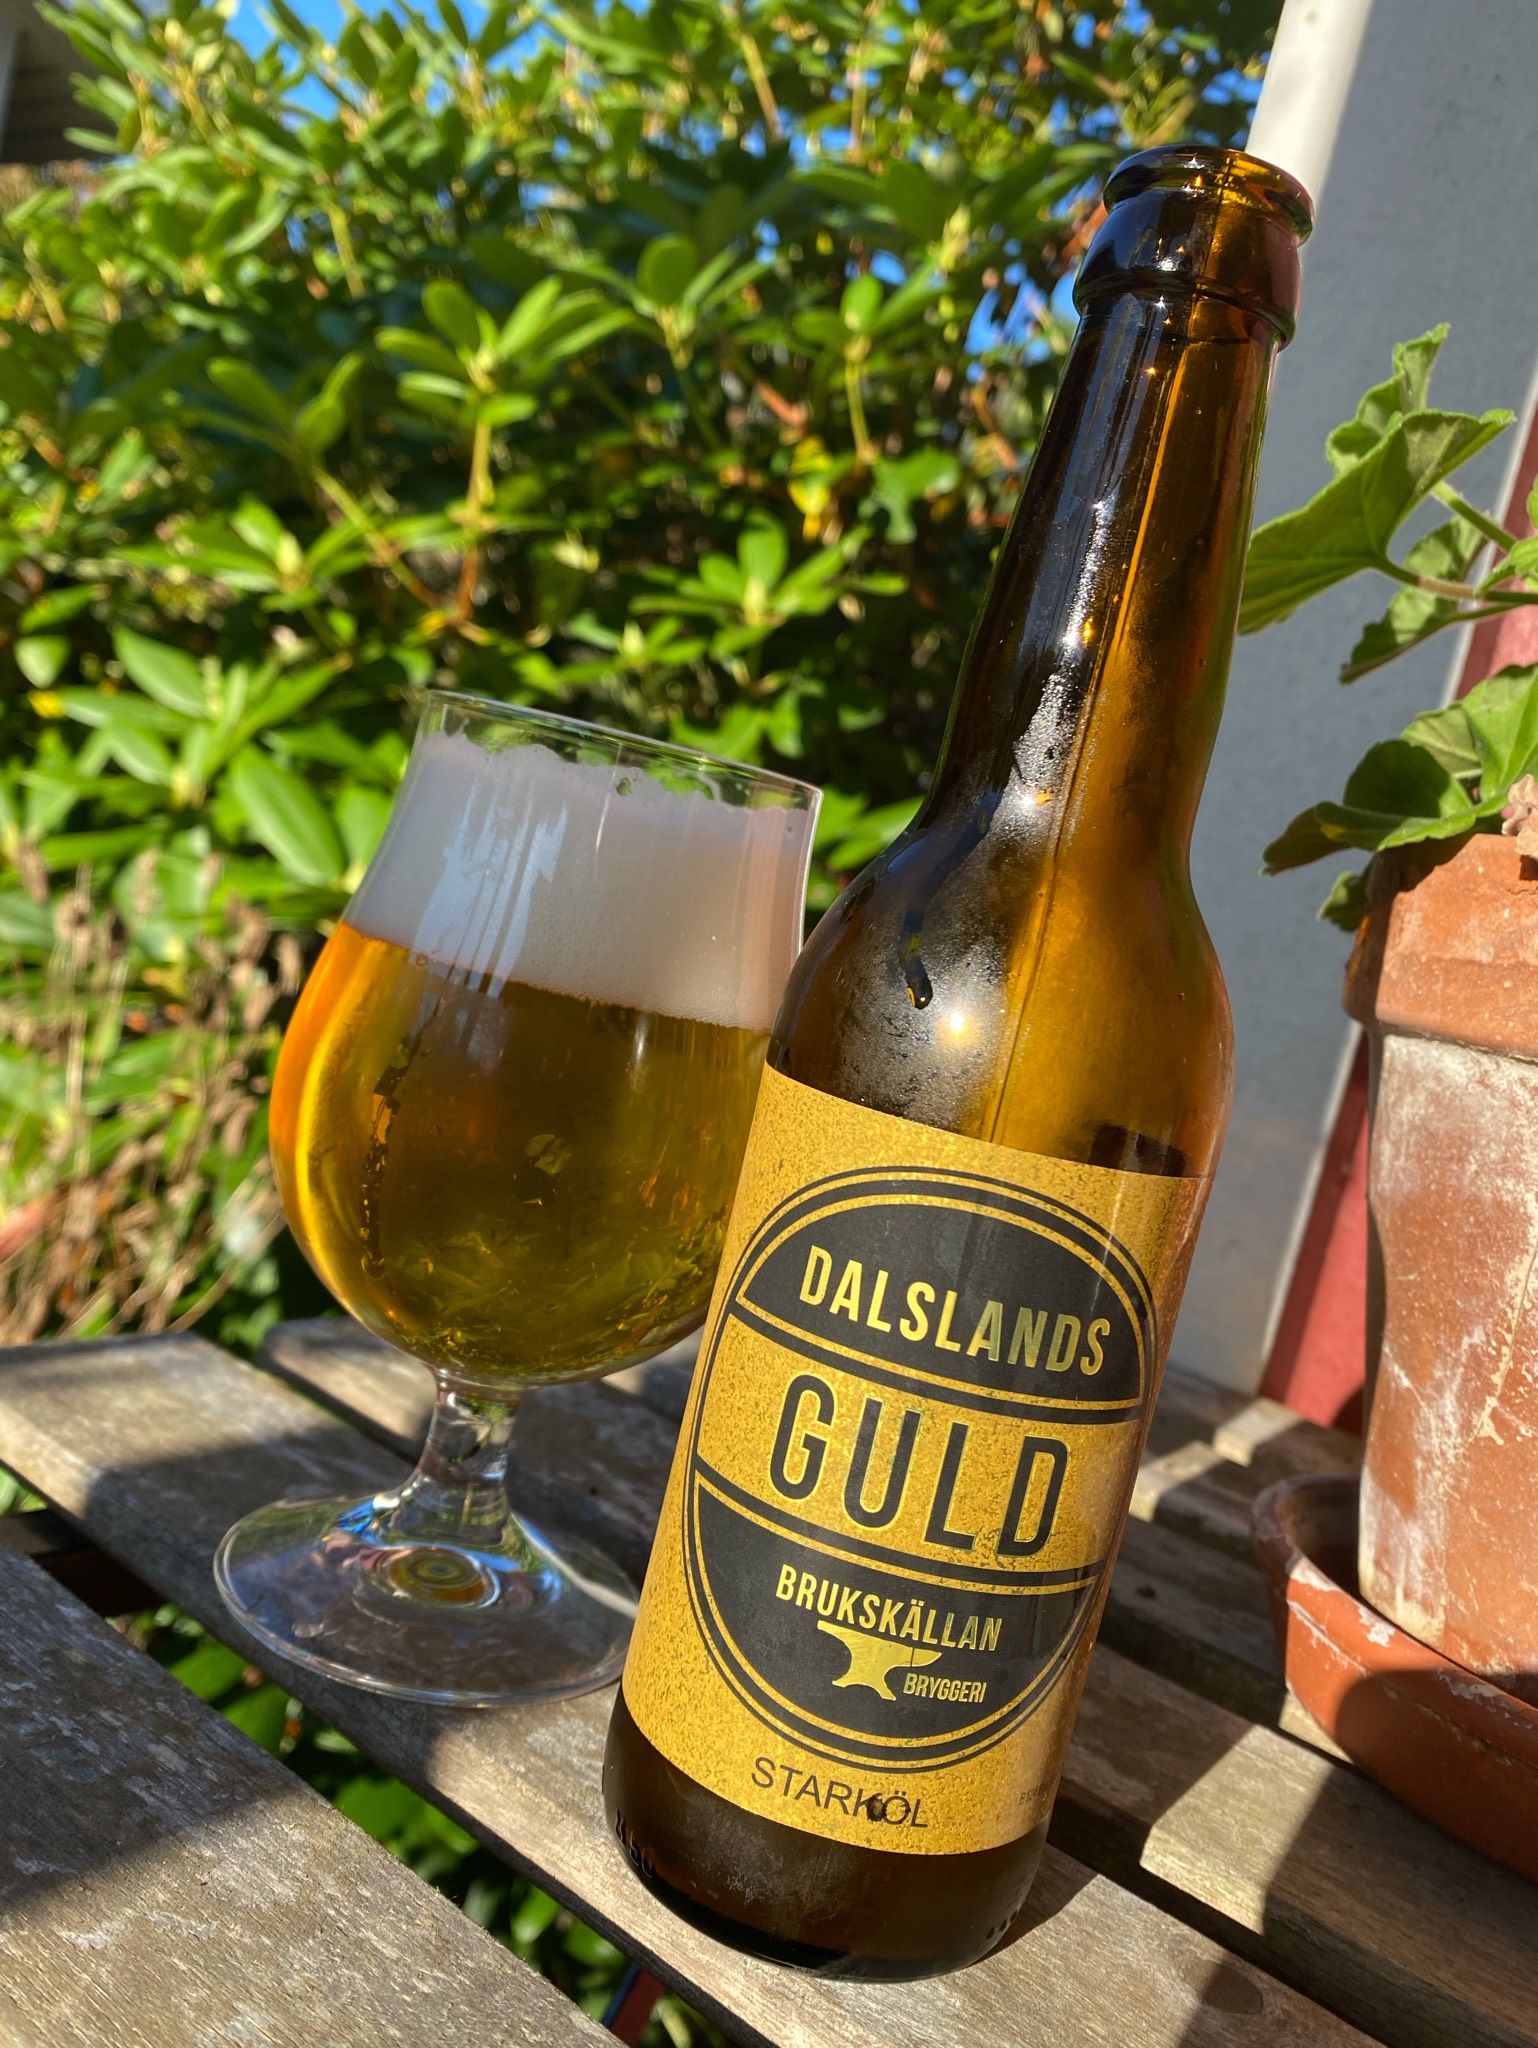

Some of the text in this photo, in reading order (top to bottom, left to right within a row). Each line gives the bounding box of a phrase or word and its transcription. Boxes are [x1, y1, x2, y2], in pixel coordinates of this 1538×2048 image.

[799, 1244, 1111, 1376] DALSLANDS
[769, 1373, 1071, 1558] GULD
[775, 1563, 1003, 1652] BRUKSKÄLLAN
[903, 1672, 987, 1703] BRYGGERI
